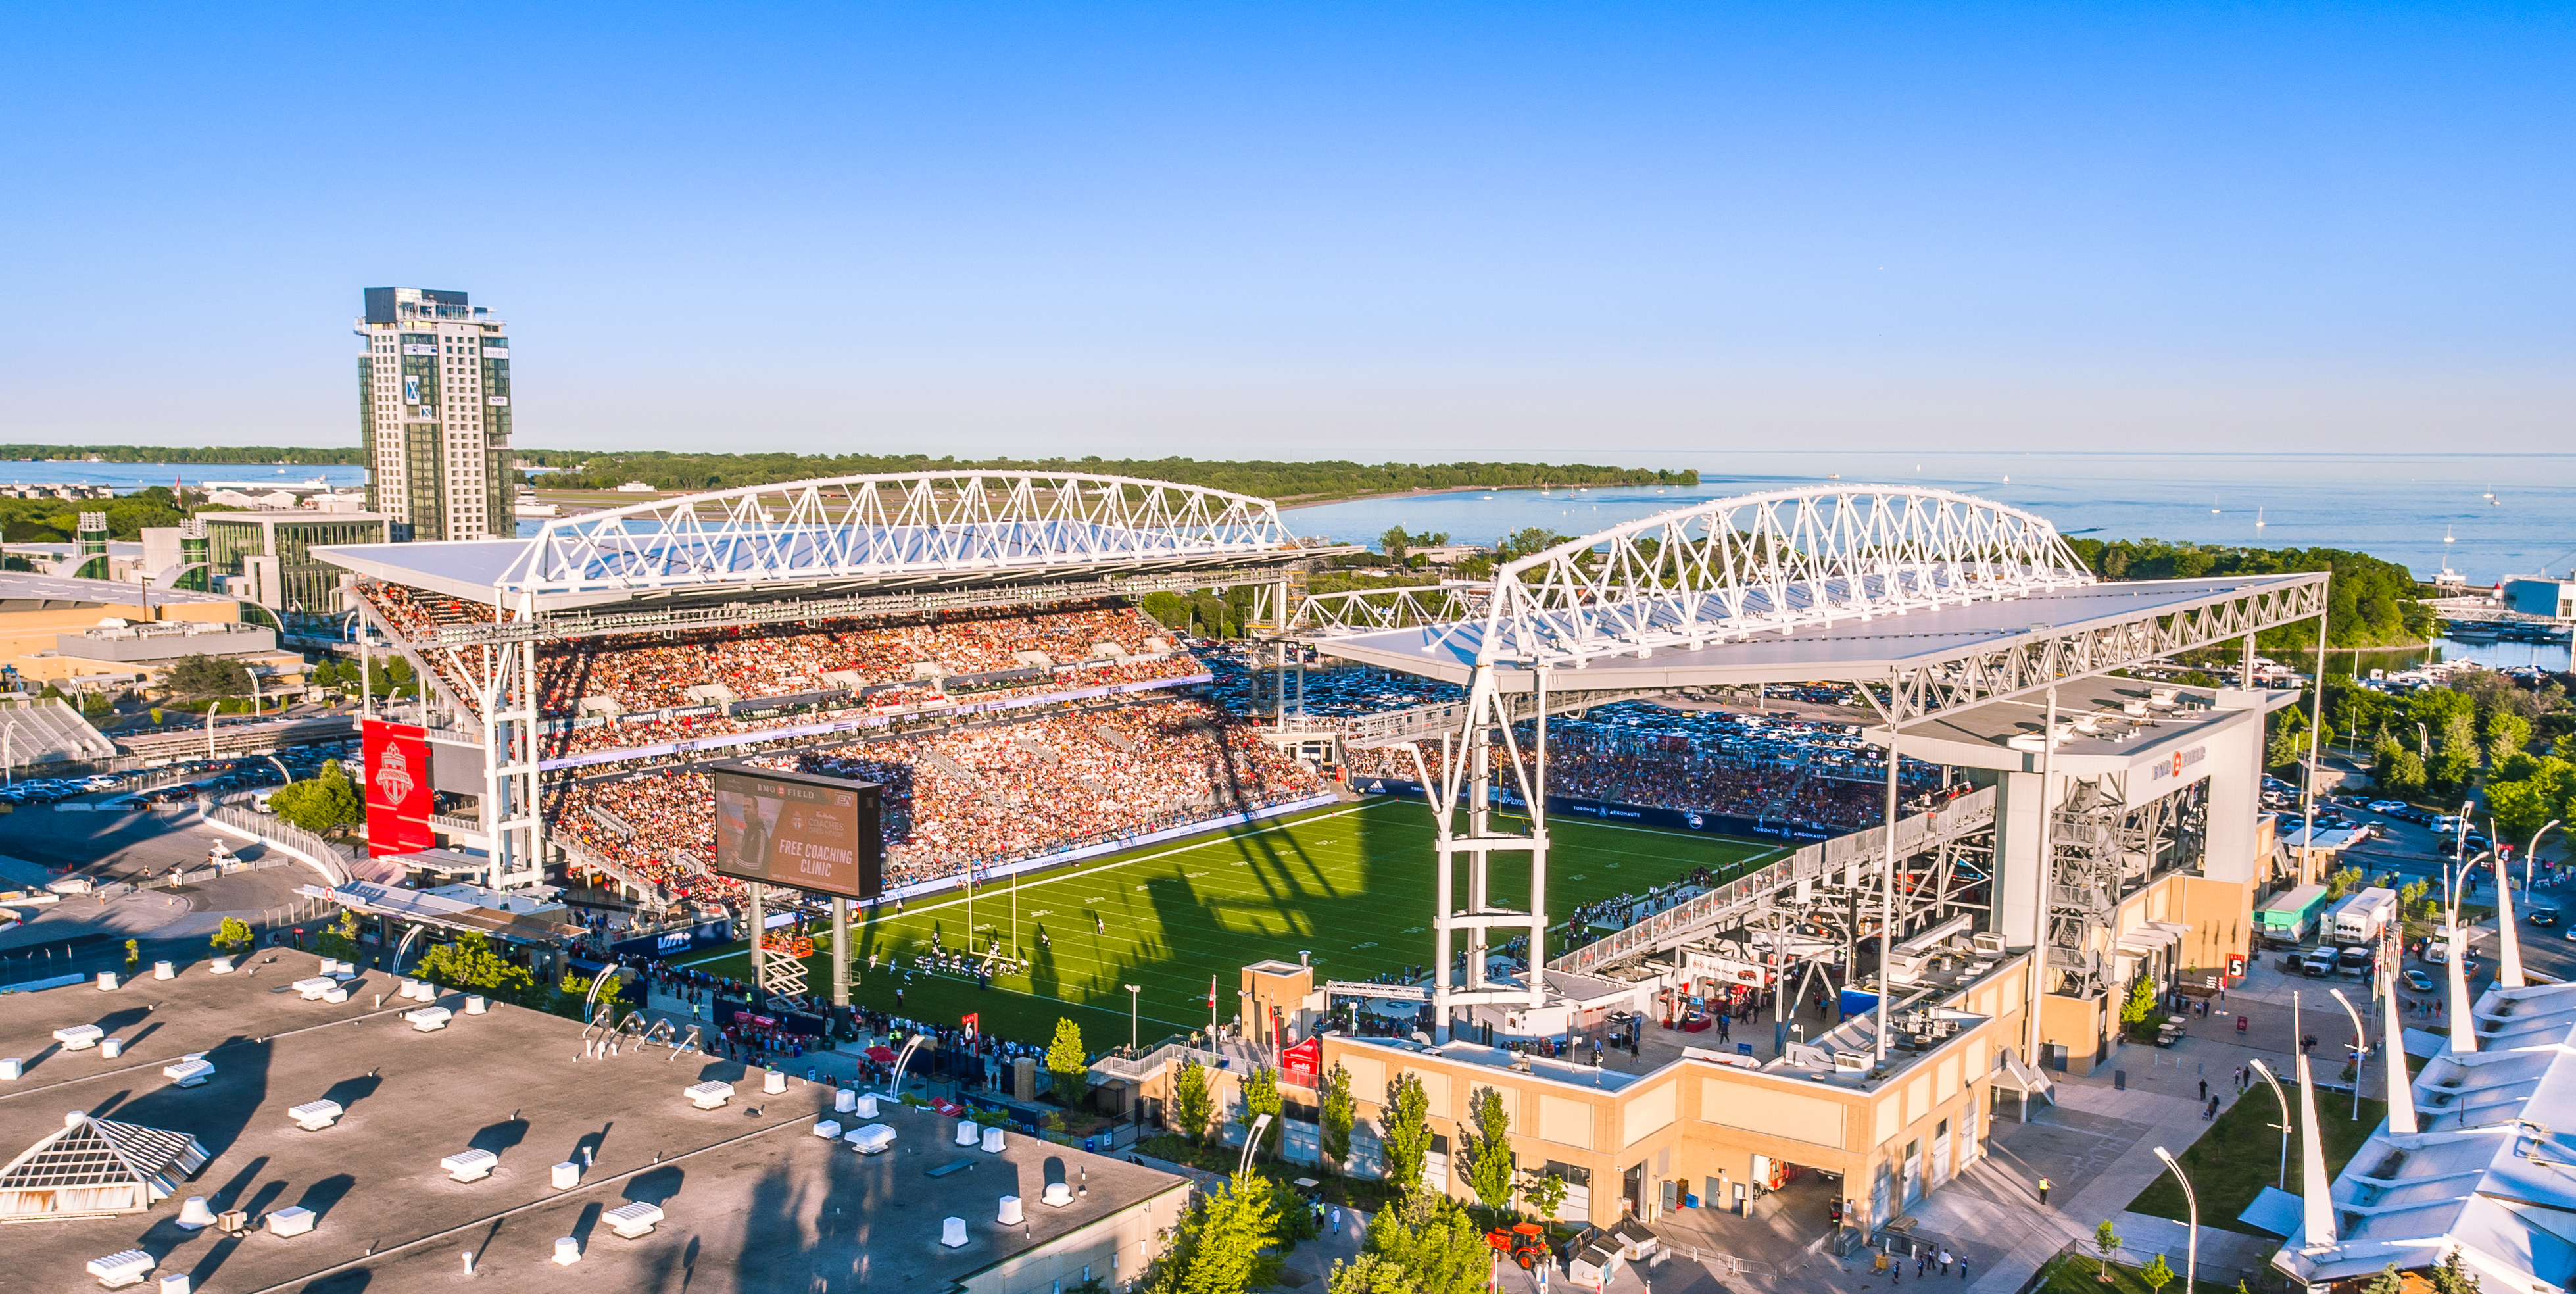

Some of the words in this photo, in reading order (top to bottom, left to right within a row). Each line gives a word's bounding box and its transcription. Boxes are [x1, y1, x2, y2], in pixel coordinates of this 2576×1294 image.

[623, 713, 657, 722] TORONTO
[675, 707, 716, 717] ARGONAUTS
[2152, 760, 2172, 781] BMO
[2182, 745, 2206, 768] FIELD
[381, 770, 408, 782] TORONTO
[757, 784, 776, 793] BMO
[787, 788, 814, 799] FIELD
[1753, 826, 1779, 834] TORONTO
[779, 839, 803, 856] FREE
[804, 843, 853, 865] COACHING
[2500, 849, 2510, 862] 4
[800, 859, 832, 877] CLINIC
[658, 932, 683, 949] VIA
[2231, 959, 2242, 976] 5
[965, 1022, 973, 1040] 6
